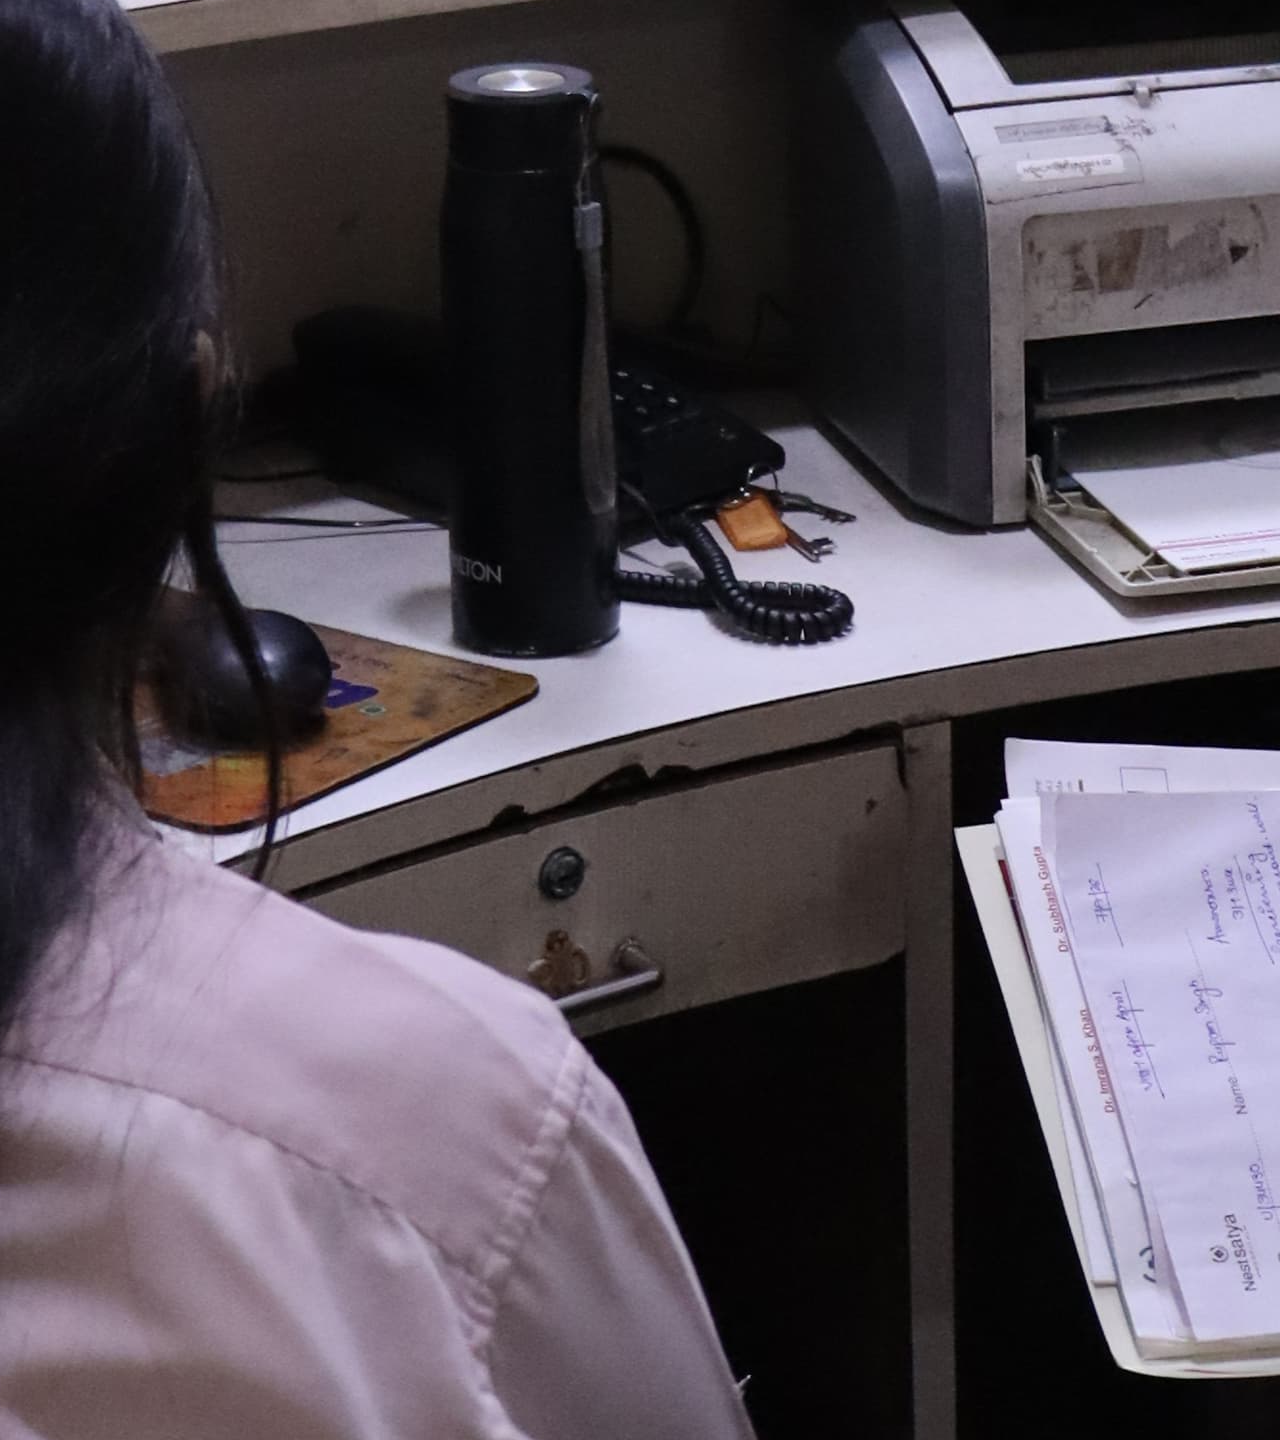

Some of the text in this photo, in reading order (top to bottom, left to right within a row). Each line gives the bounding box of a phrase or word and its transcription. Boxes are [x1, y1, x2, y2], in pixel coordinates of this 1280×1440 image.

[1033, 846, 1050, 881] Gupta
[1041, 882, 1065, 934] Subhash
[1080, 1009, 1096, 1039] Khan
[1092, 1052, 1110, 1095] Imrana
[1227, 1076, 1248, 1115] Name
